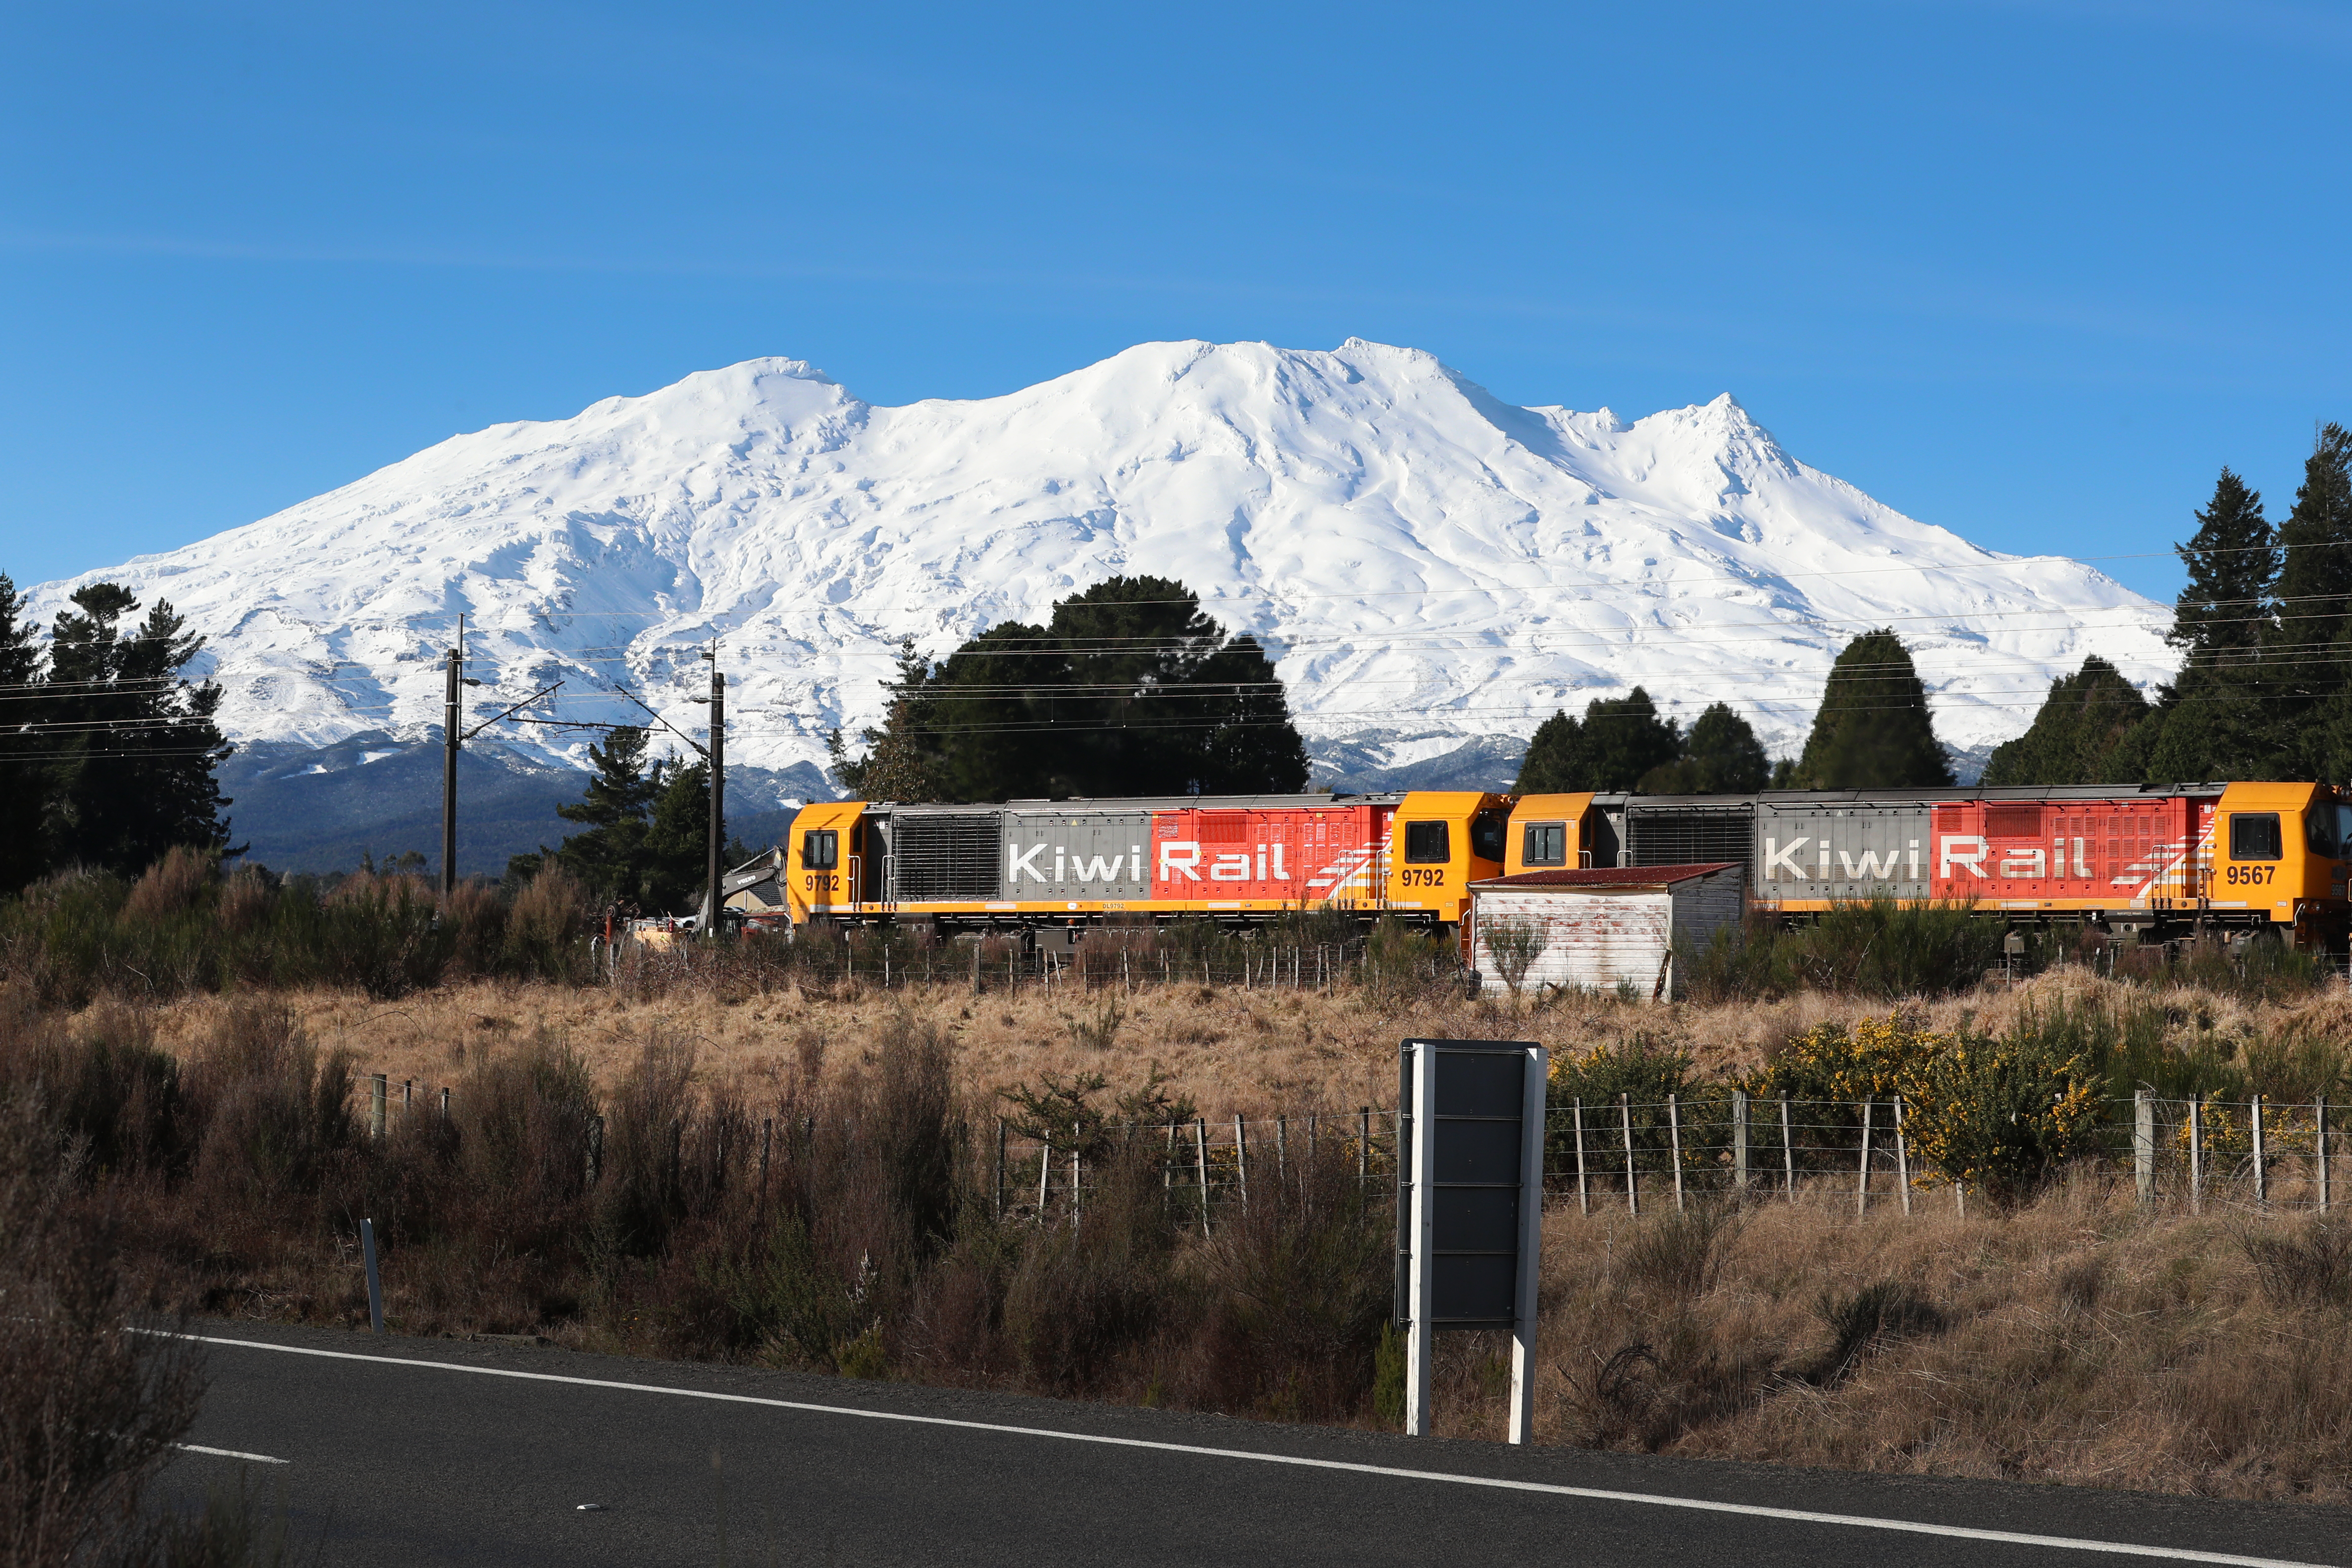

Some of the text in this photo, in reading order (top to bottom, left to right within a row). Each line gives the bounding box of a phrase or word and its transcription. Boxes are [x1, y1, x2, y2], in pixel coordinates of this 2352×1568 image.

[736, 875, 757, 885] VOLVO
[805, 874, 839, 891] 9792
[1402, 868, 1444, 887] 9792
[2227, 865, 2276, 885] 9567
[2331, 884, 2346, 896] 9567
